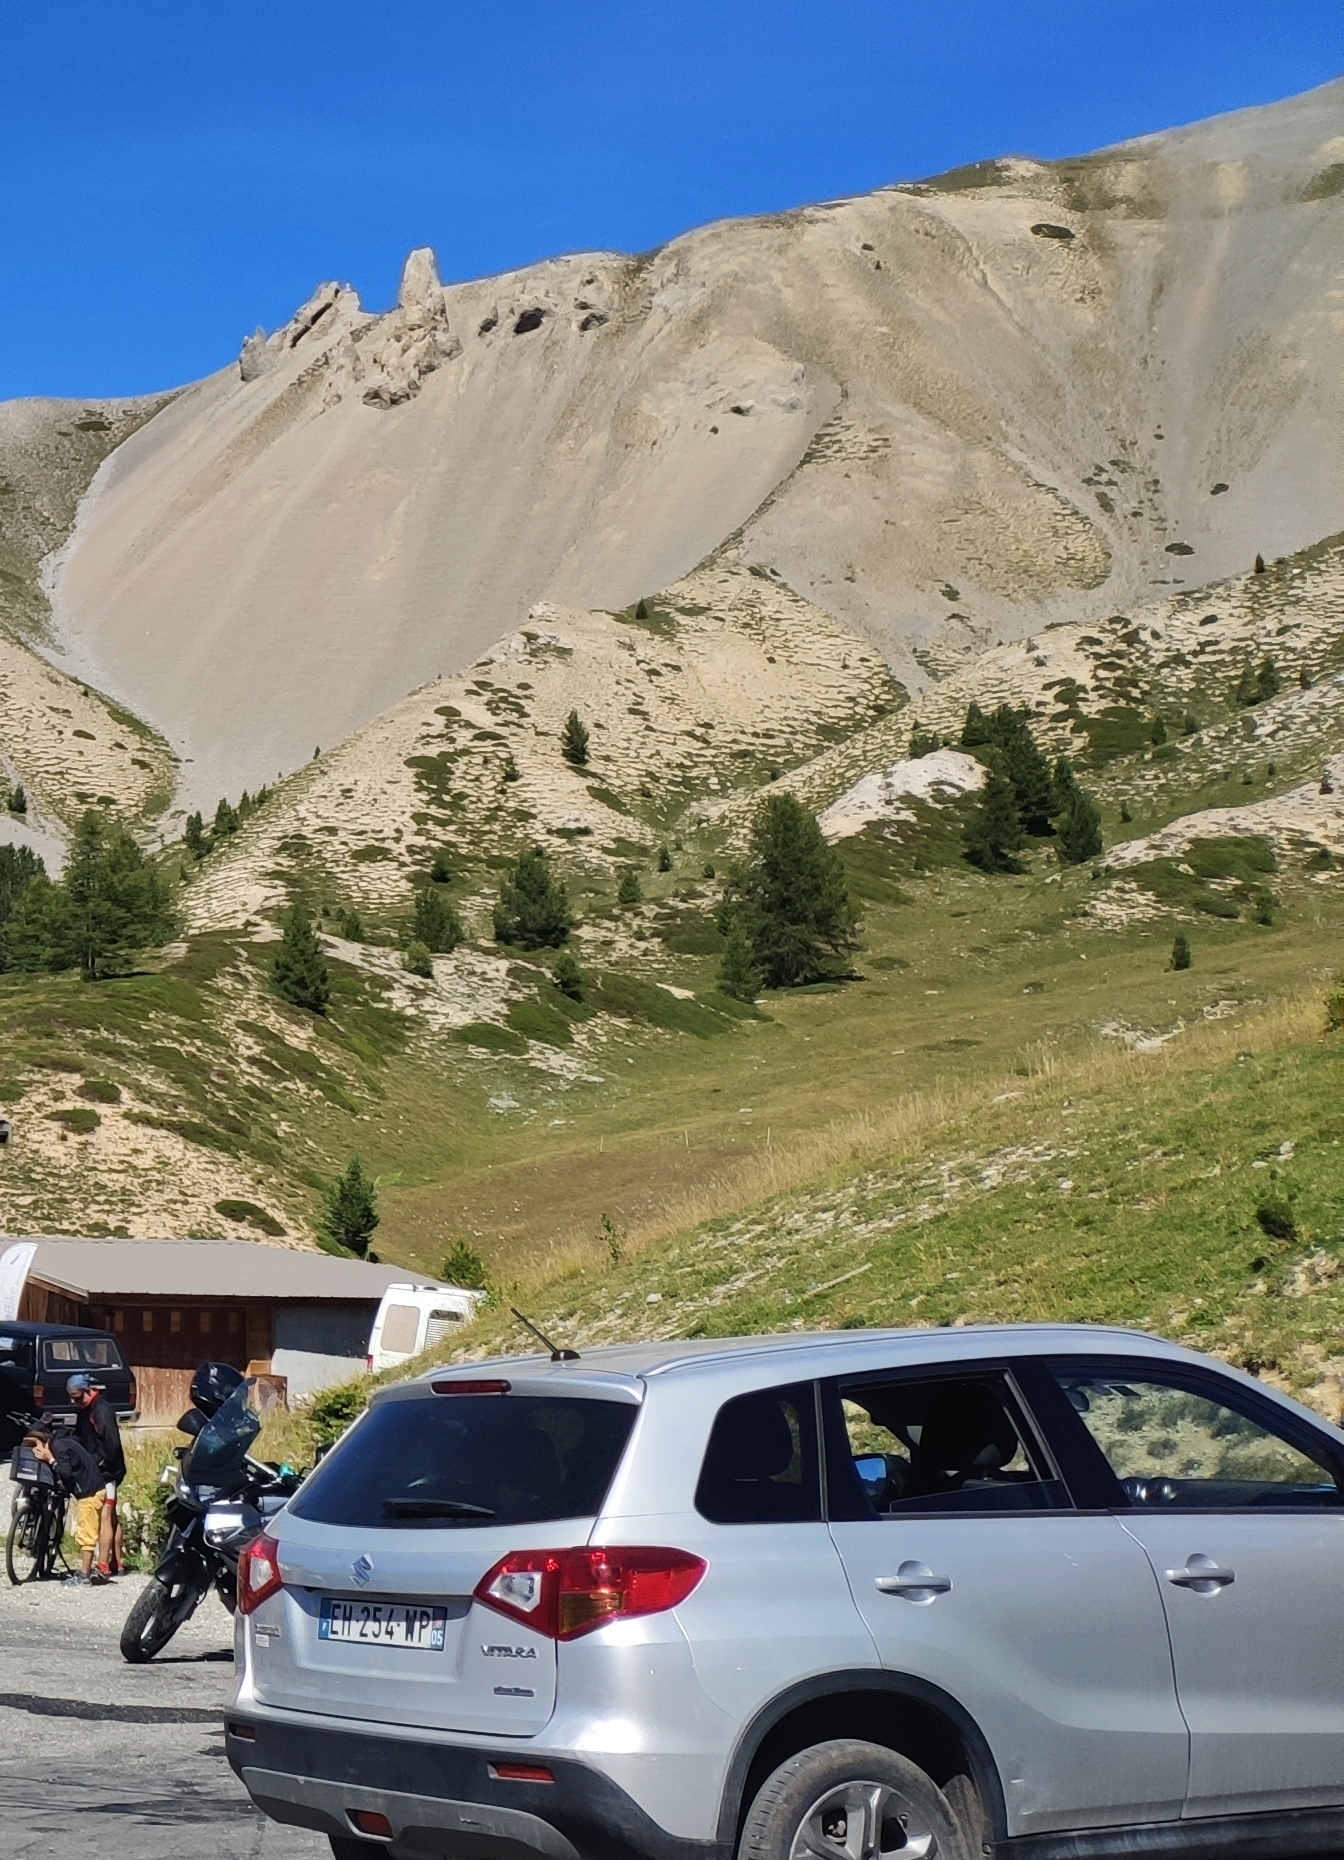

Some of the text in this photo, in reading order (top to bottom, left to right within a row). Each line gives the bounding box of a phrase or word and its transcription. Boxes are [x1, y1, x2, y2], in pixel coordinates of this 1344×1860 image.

[330, 1603, 444, 1646] EH-254-WP 05
[480, 1644, 538, 1660] VITARA
